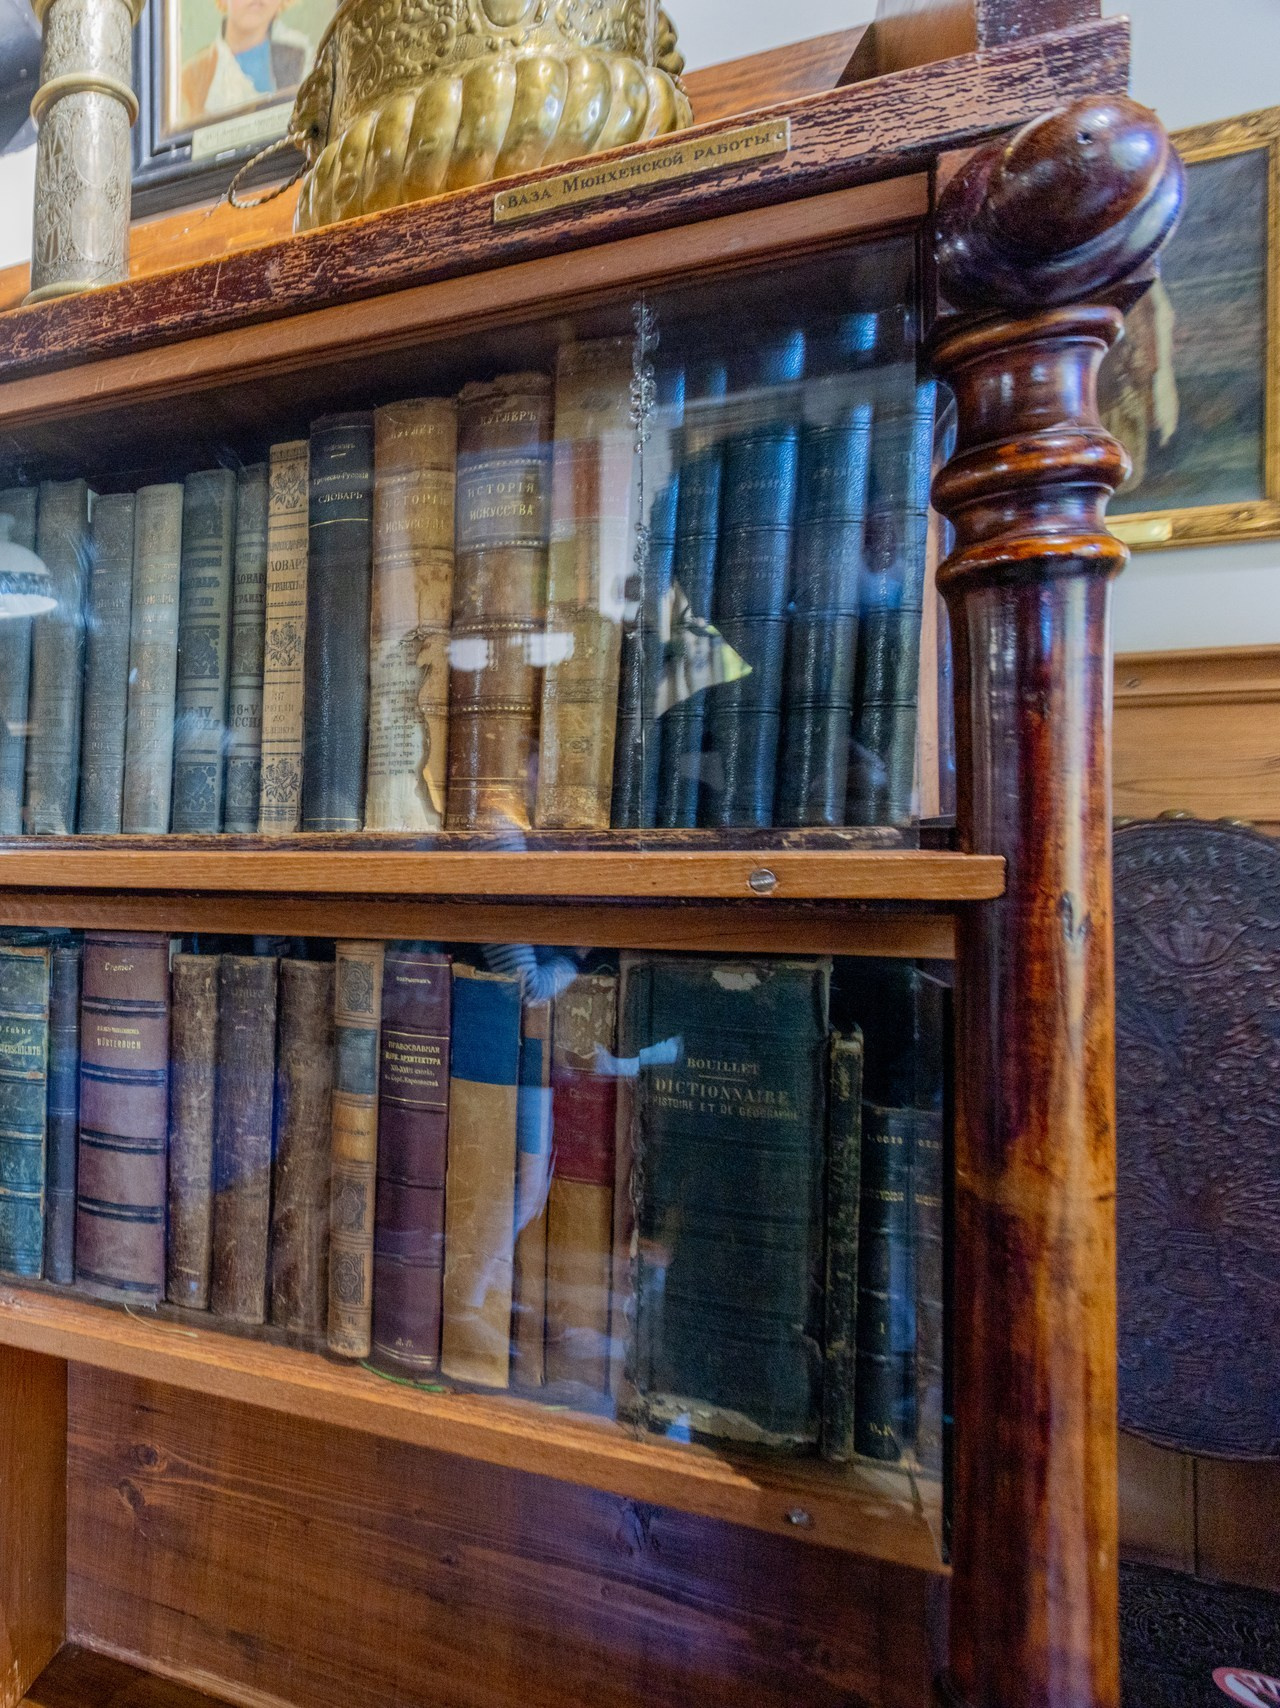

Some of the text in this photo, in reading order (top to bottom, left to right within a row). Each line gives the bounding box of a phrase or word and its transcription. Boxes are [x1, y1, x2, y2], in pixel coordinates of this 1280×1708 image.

[318, 491, 363, 504] СЛОВАРЬ
[687, 1057, 760, 1075] BOUILLET
[655, 1077, 789, 1106] DICTIONNAIRE
